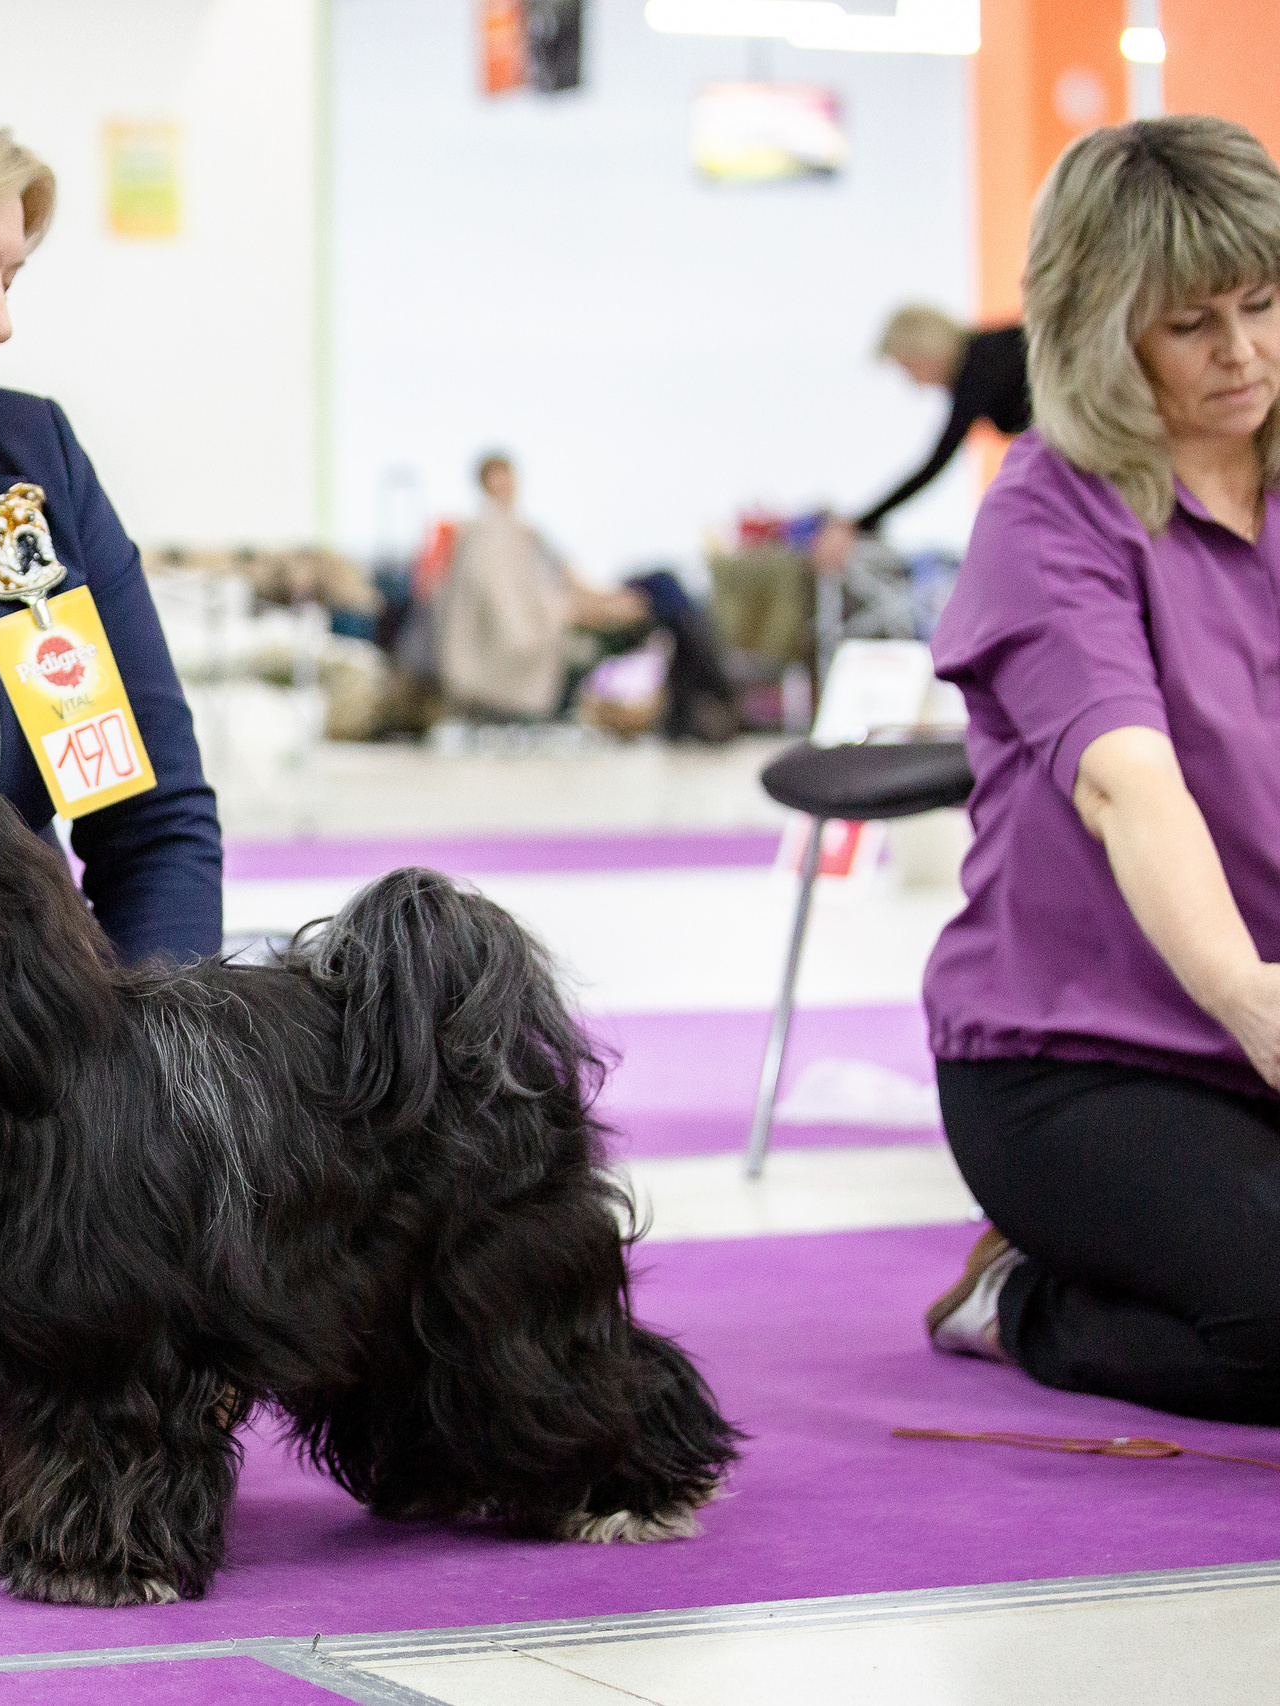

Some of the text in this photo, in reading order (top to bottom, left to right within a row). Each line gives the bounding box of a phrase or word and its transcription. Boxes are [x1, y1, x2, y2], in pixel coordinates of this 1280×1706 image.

[15, 642, 97, 684] Pedigree
[52, 694, 93, 720] VITAL
[57, 713, 134, 789] 190
